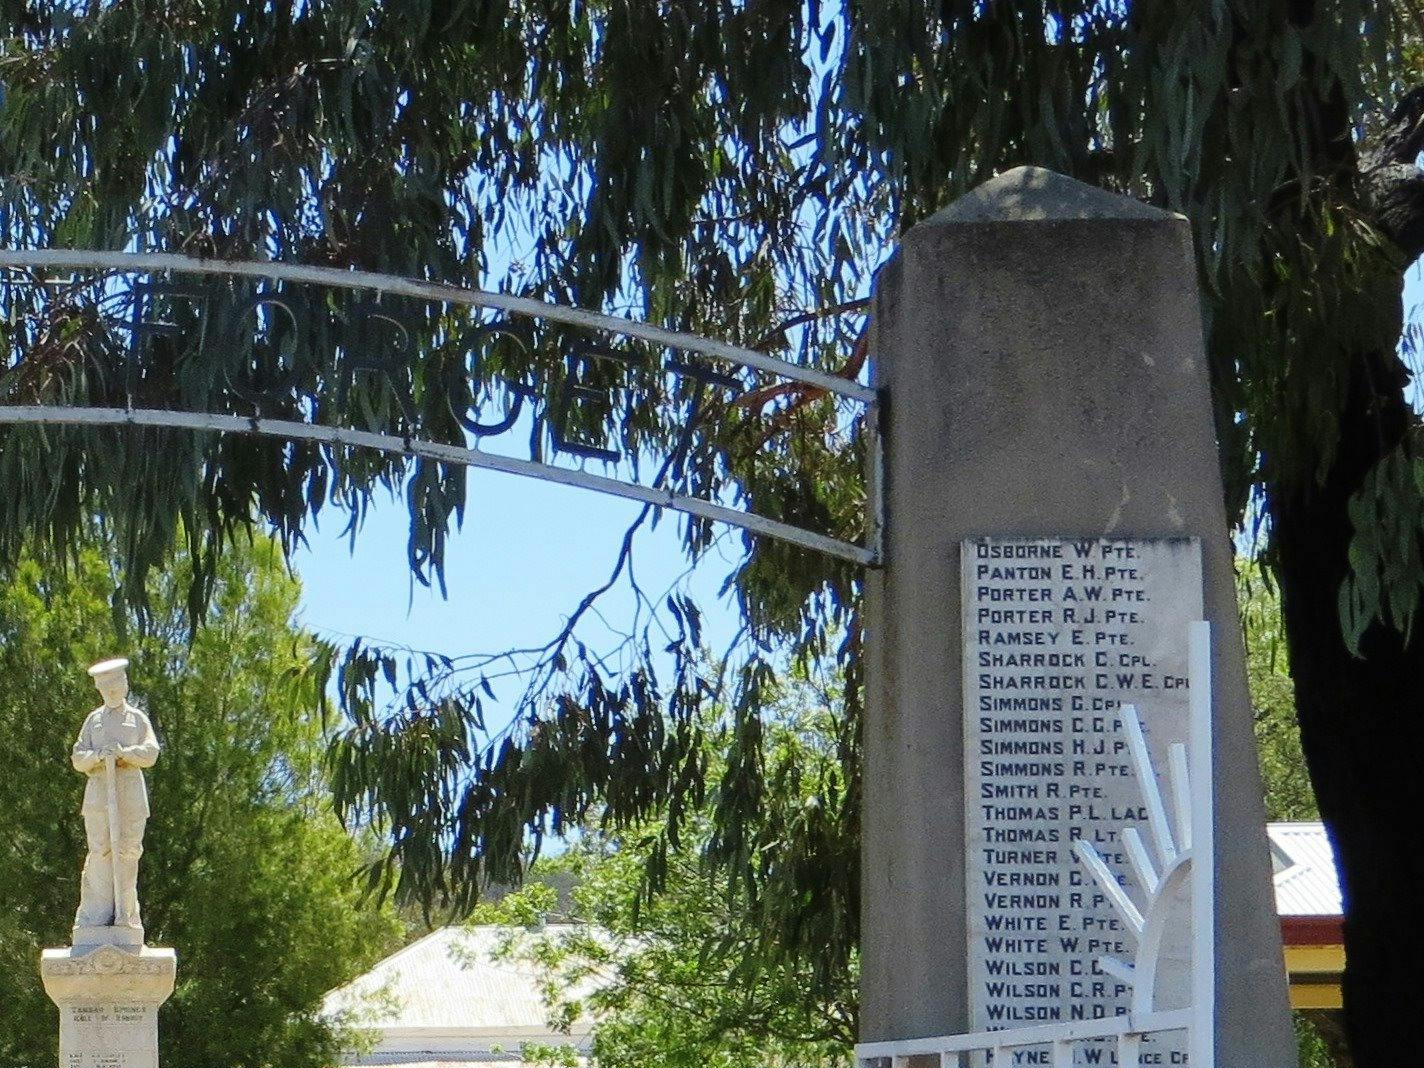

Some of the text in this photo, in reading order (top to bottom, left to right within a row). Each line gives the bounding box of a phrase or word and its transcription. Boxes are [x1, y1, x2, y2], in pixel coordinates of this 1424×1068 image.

[977, 543, 1063, 558] OSBORNE
[978, 565, 1051, 579] PANTON
[978, 587, 1051, 601] PORTER
[978, 608, 1052, 623] PORTER
[978, 630, 1060, 645] RAMSEY
[979, 652, 1085, 667] SHARROCK
[979, 675, 1085, 689] SHARROCK
[980, 696, 1063, 711] SIMMONS
[980, 718, 1063, 732] SIMMONS
[980, 740, 1063, 754] SIMMONS
[981, 762, 1064, 776] SIMMONS
[982, 783, 1037, 798] SMITH
[982, 805, 1059, 820] THOMAS
[982, 827, 1059, 842] THOMAS
[983, 849, 1057, 864] TURNER
[984, 872, 1059, 886] VERNON
[984, 895, 1059, 908] VERNON
[984, 916, 1046, 930] WHITE
[985, 938, 1047, 953] WHITE
[985, 961, 1059, 975] WILSON
[986, 983, 1059, 997] WILSON
[986, 1005, 1059, 1020] WILSON
